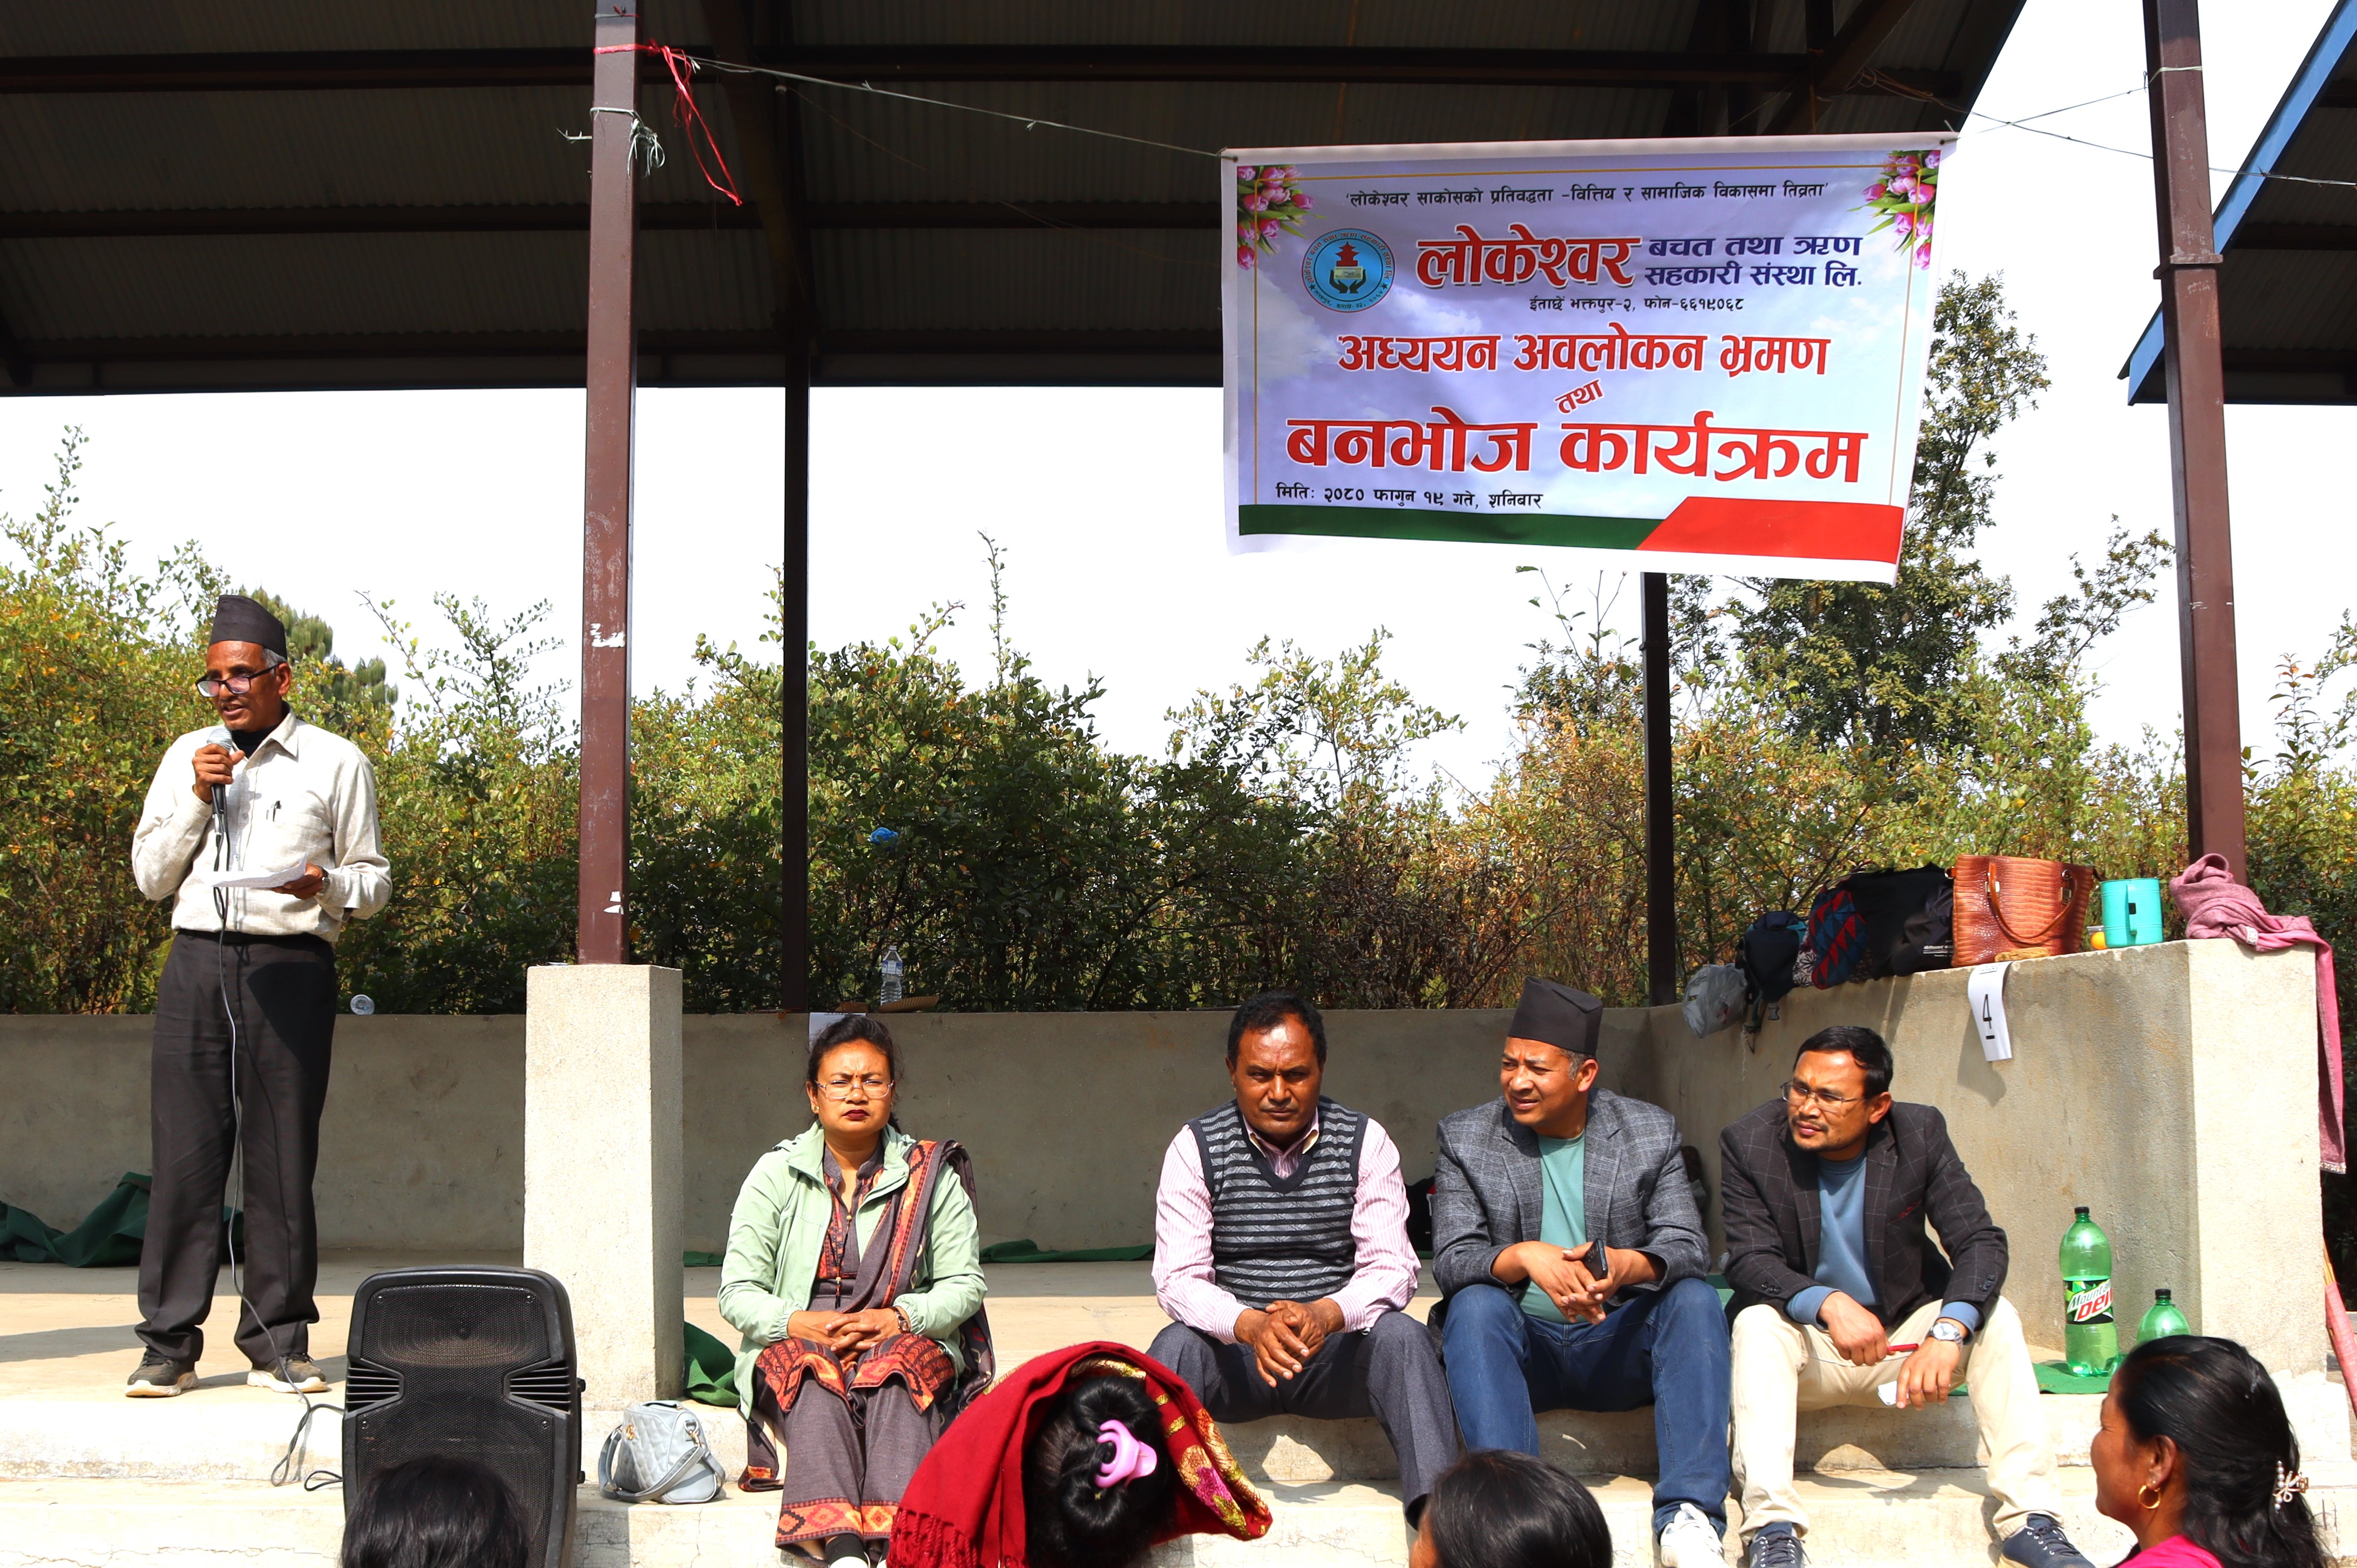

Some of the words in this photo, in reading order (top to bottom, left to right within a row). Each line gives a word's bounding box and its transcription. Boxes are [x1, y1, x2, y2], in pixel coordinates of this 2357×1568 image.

[1417, 188, 1484, 206] साकोसको
[1623, 187, 1634, 202] र
[1641, 182, 1707, 201] सामाजिक
[1713, 181, 1776, 199] विकासमा
[1415, 223, 1642, 288] लोकेश्वर
[1648, 237, 1716, 257] बचत
[1725, 236, 1784, 256] तथा
[1793, 236, 1863, 256] ऋण
[1644, 260, 1743, 286] सहकारी
[1749, 262, 1817, 287] संस्था
[1825, 260, 1862, 287] लि.
[1570, 298, 1636, 314] भक्तपुर-२,
[1338, 335, 1501, 372] अध्ययन
[1513, 322, 1708, 372] अवलोकन
[1720, 335, 1831, 378] भ्रमण
[1557, 379, 1603, 413] तथा
[1287, 406, 1538, 472] बनभोज
[1560, 410, 1869, 483] कार्यक्रम
[1324, 487, 1365, 502] २०८०
[1373, 488, 1417, 506] फागुन
[1452, 490, 1479, 510] गते,
[1488, 490, 1543, 510] शनिबार
[1982, 994, 1993, 1030] 4
